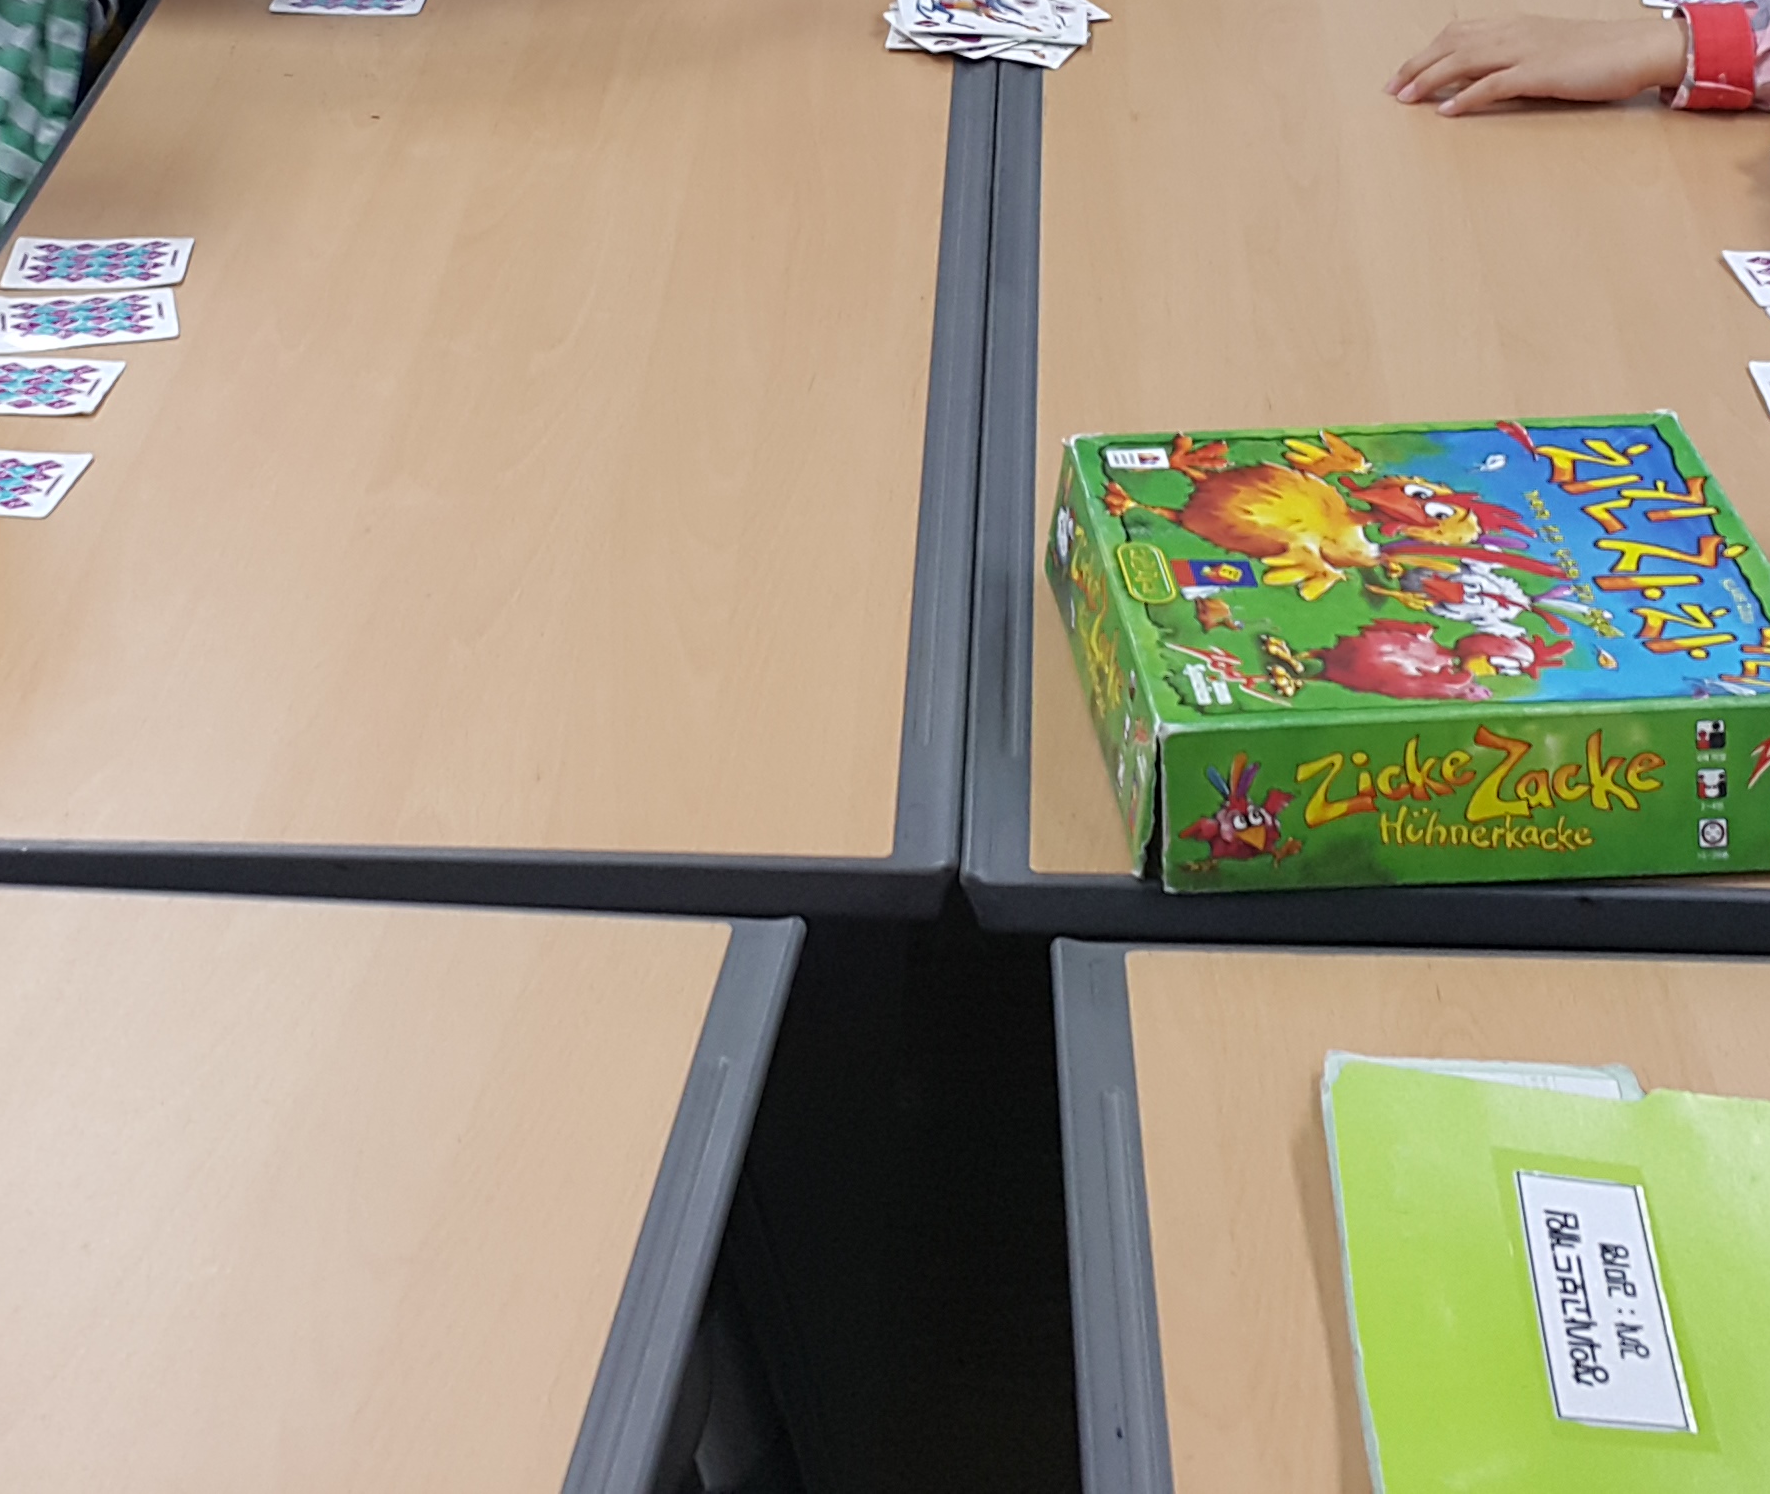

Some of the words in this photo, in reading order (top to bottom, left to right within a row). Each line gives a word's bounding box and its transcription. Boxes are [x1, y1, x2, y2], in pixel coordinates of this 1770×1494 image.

[1534, 438, 1748, 659] 치킨차차
[1295, 735, 1477, 828] Zicke
[1465, 724, 1666, 823] Zacke
[1379, 806, 1596, 852] Hühnerkacke
